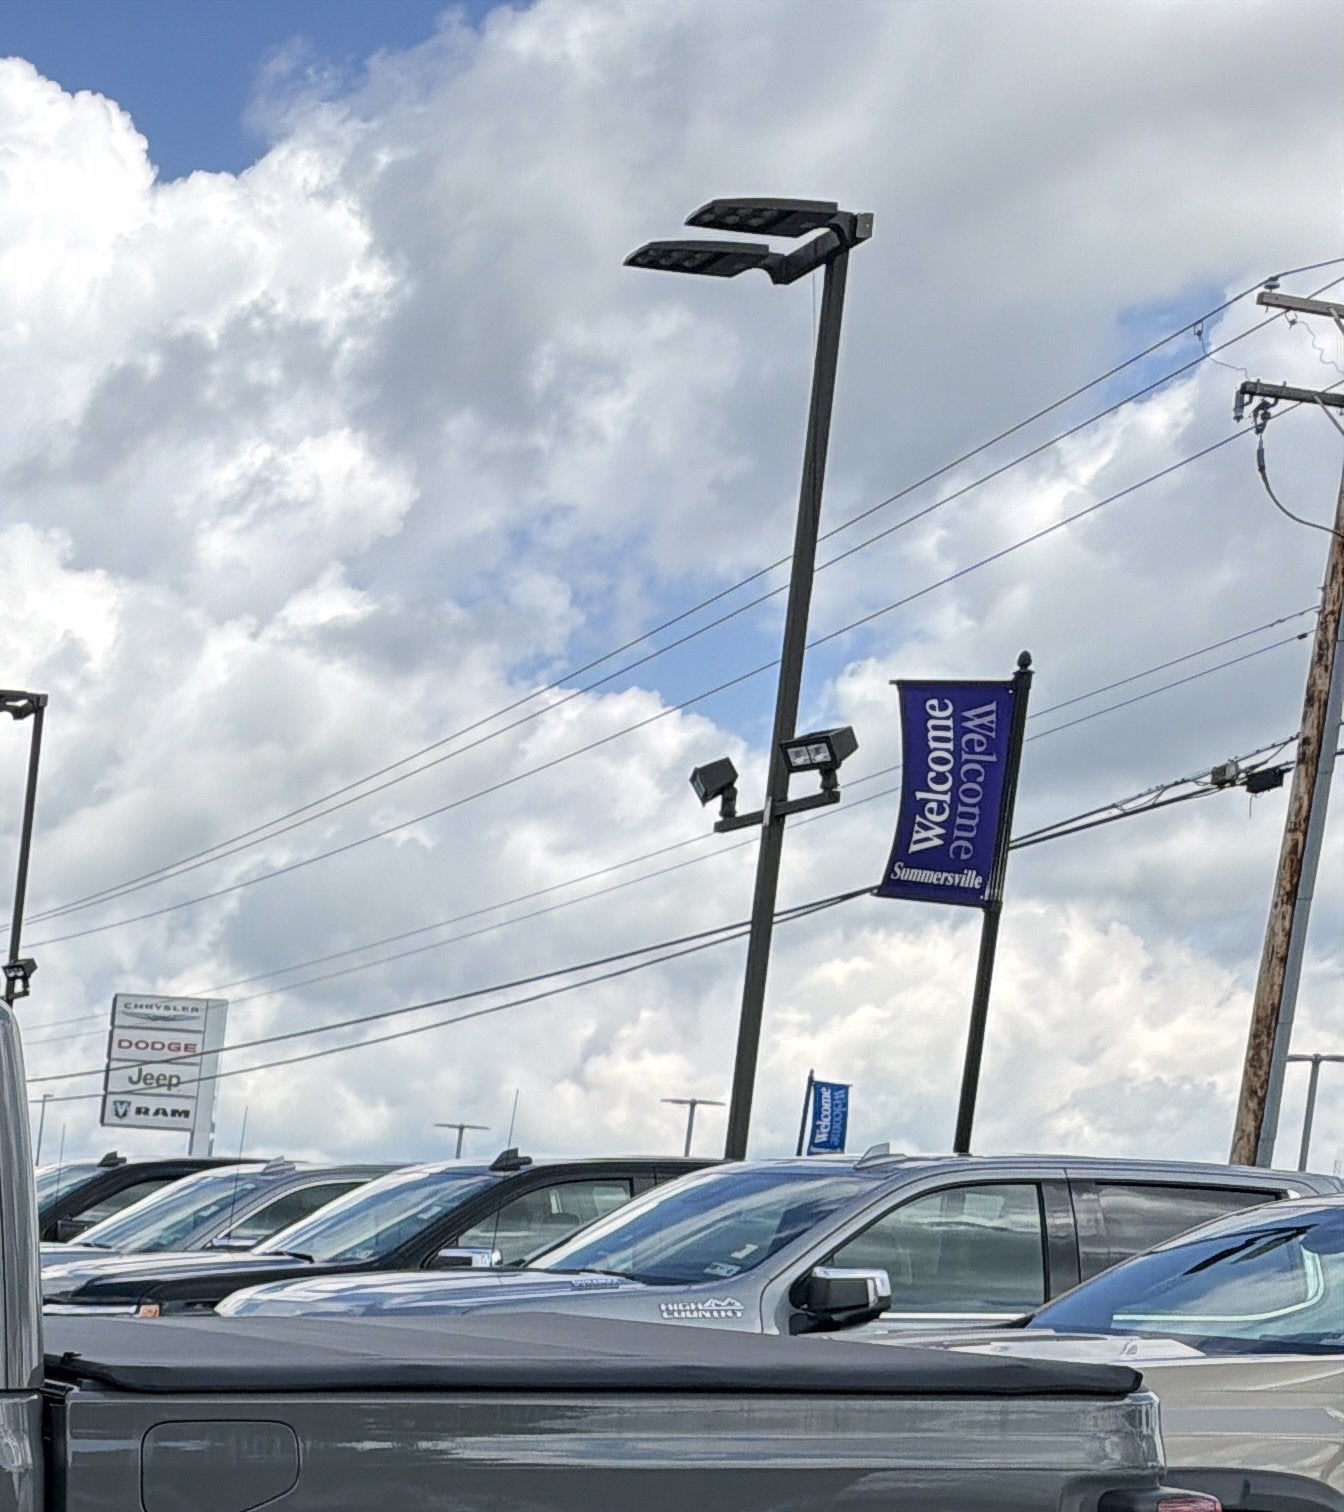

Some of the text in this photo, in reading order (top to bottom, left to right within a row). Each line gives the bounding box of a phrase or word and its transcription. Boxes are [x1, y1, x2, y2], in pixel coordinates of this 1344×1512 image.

[908, 698, 954, 855] Welcome
[949, 701, 998, 860] Welcome
[890, 861, 983, 889] Summersville
[123, 1002, 200, 1013] CHRYSLER
[117, 1039, 198, 1053] DODGE
[128, 1067, 181, 1091] Jeep
[134, 1106, 191, 1118] RAM
[814, 1086, 831, 1144] Welcome
[660, 1302, 704, 1311] HIGH
[662, 1310, 743, 1319] COUNTRY
